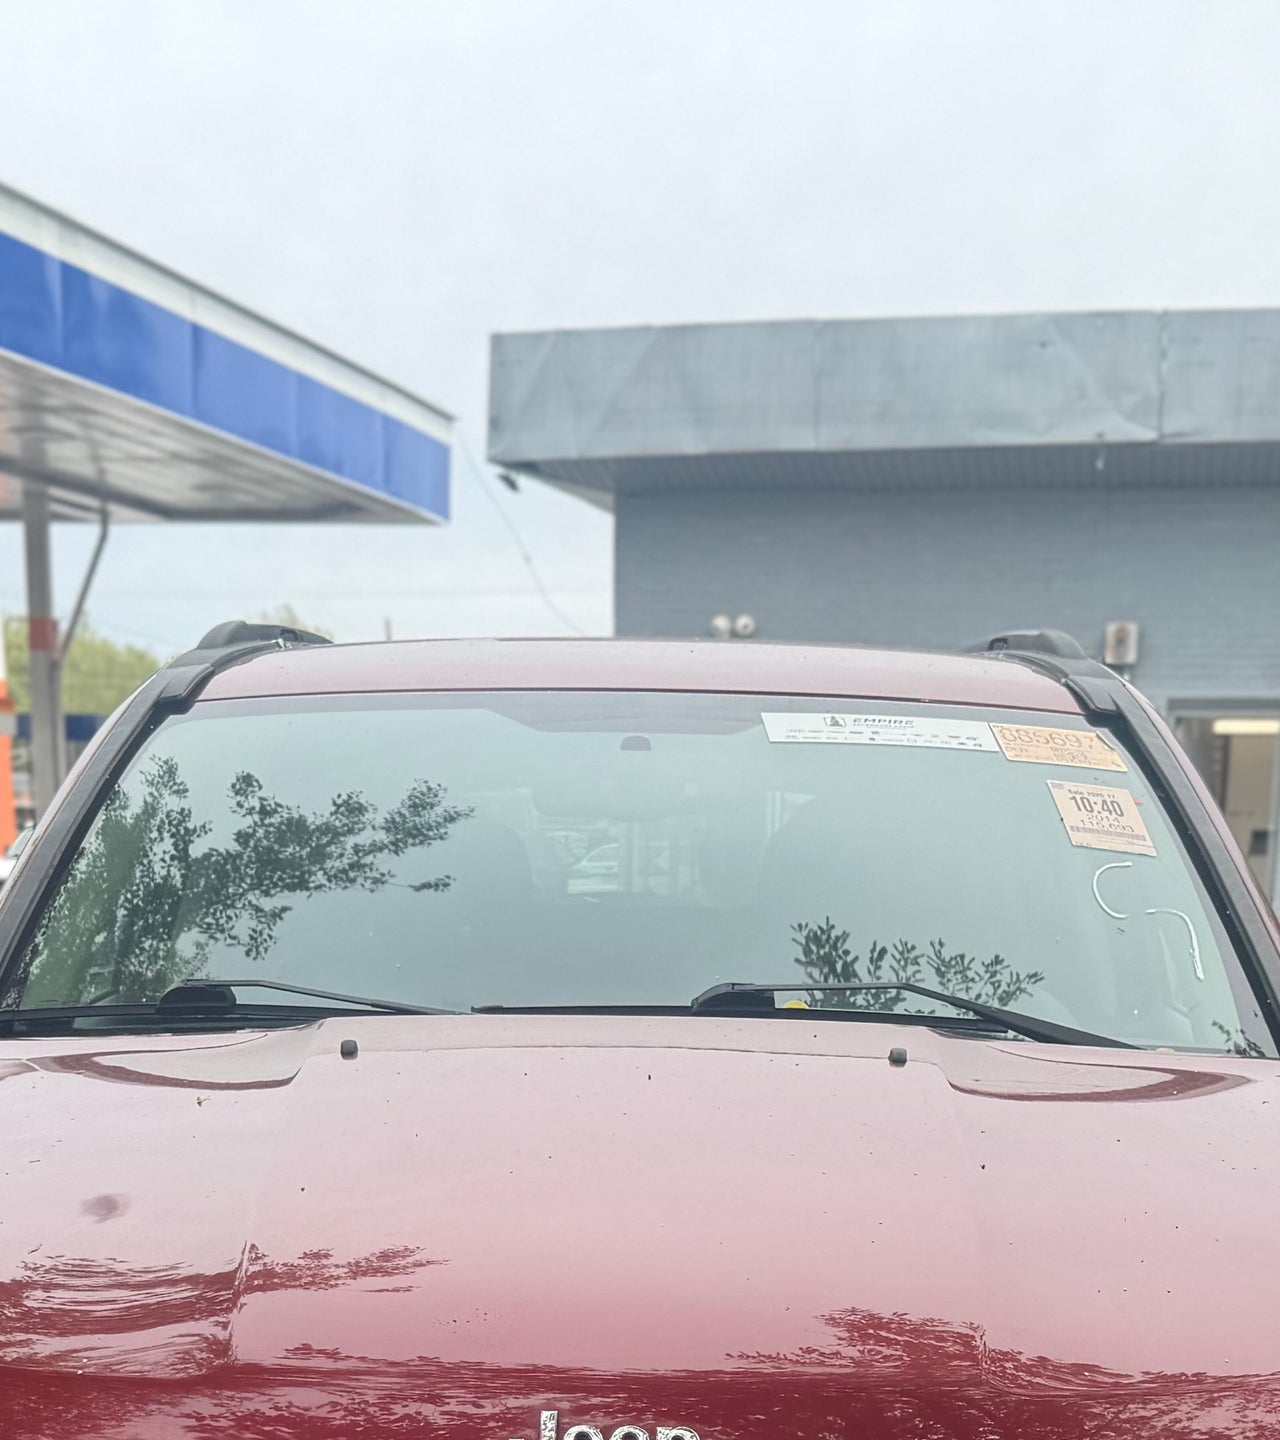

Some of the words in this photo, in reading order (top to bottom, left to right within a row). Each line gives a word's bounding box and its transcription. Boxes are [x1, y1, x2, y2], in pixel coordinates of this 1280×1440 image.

[852, 717, 914, 726] EMPIRE
[1069, 795, 1124, 818] 10:40
[1086, 814, 1120, 824] 2014
